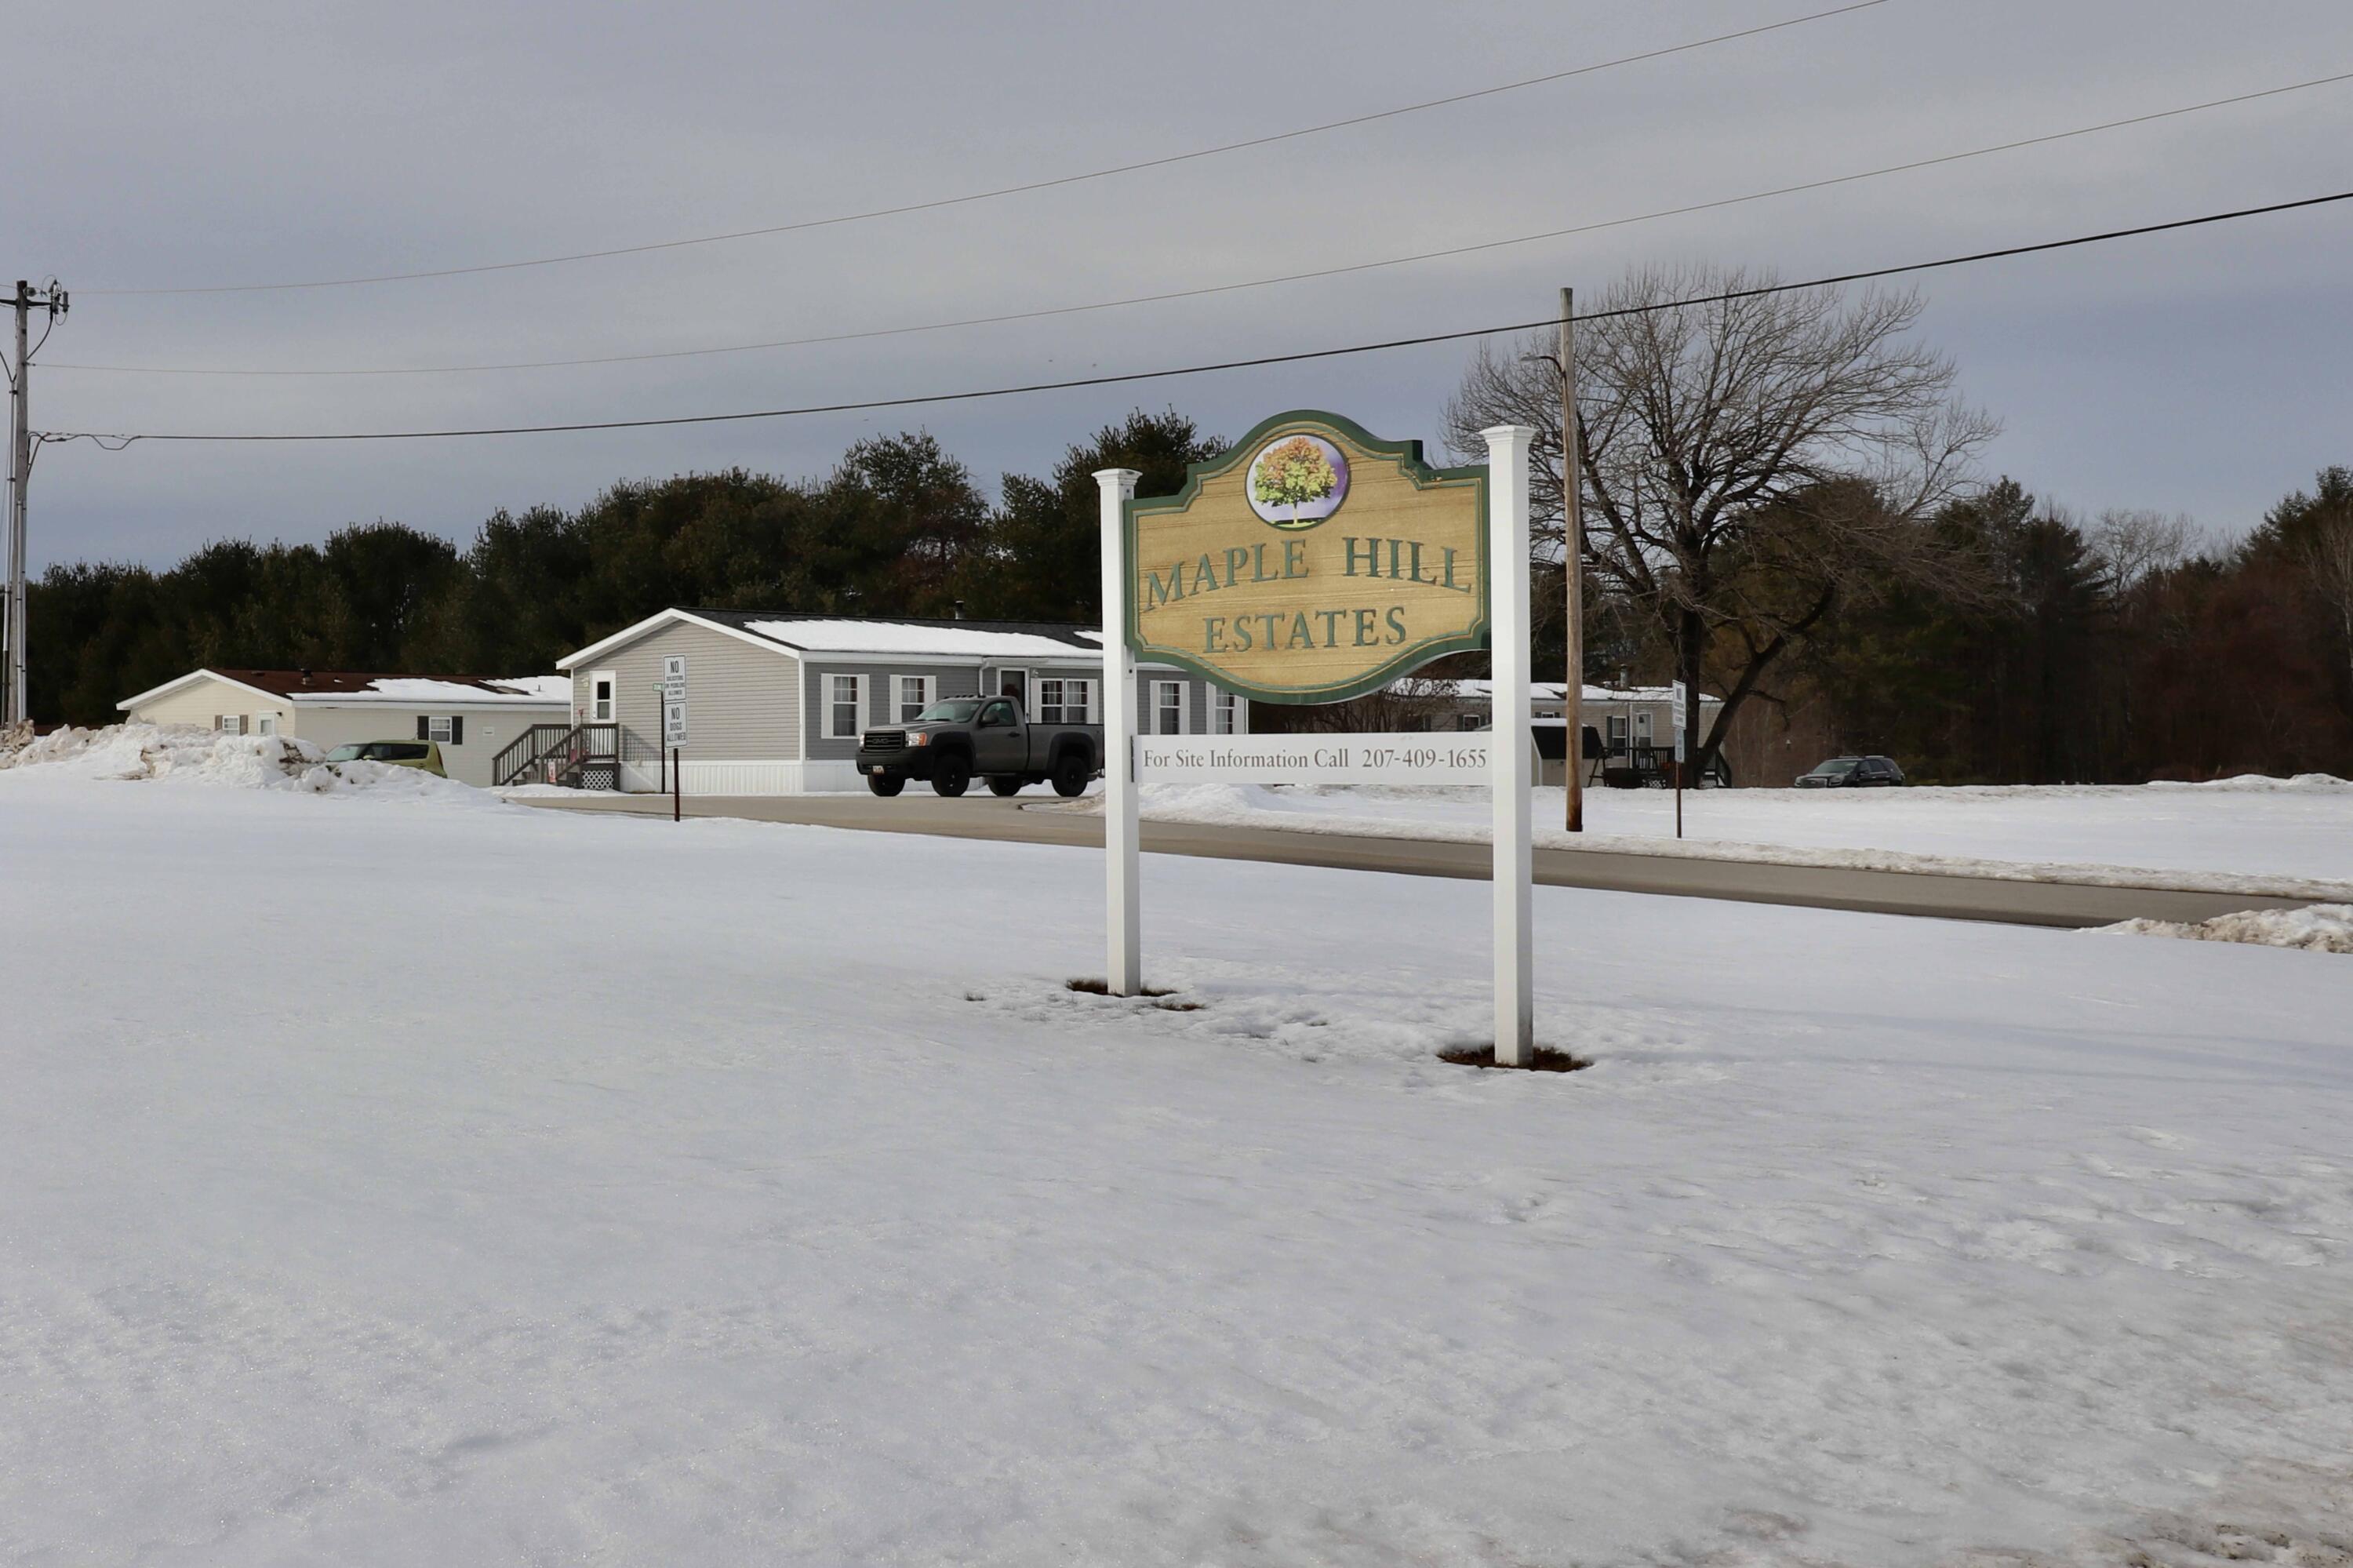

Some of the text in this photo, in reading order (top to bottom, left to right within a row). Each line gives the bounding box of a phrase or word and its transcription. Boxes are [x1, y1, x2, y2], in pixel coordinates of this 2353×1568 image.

[1143, 537, 1471, 613] MAPLE HILL
[1202, 606, 1406, 653] ESTATES
[670, 660, 679, 673] NO
[671, 707, 680, 719] NO
[667, 732, 686, 741] ALLOWED
[1144, 748, 1486, 768] For Site Information Call 207-409-1655
